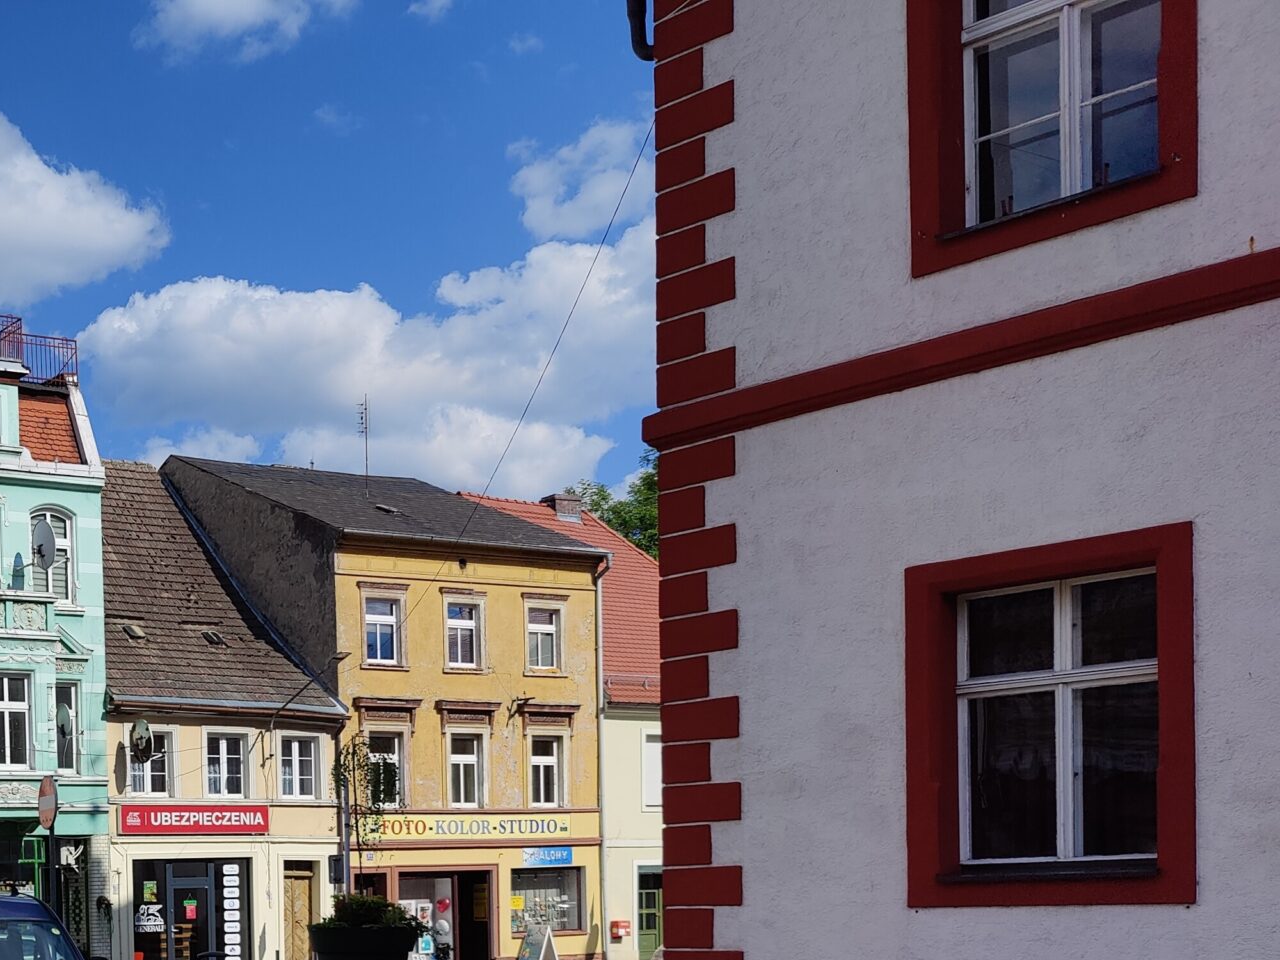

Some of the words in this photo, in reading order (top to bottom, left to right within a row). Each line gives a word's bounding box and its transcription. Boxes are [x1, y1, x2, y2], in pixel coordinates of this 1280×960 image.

[150, 811, 265, 826] UBEZPIECZENIA
[381, 819, 427, 836] FOTO
[435, 819, 493, 835] KOLOR
[498, 818, 558, 834] STUDIO
